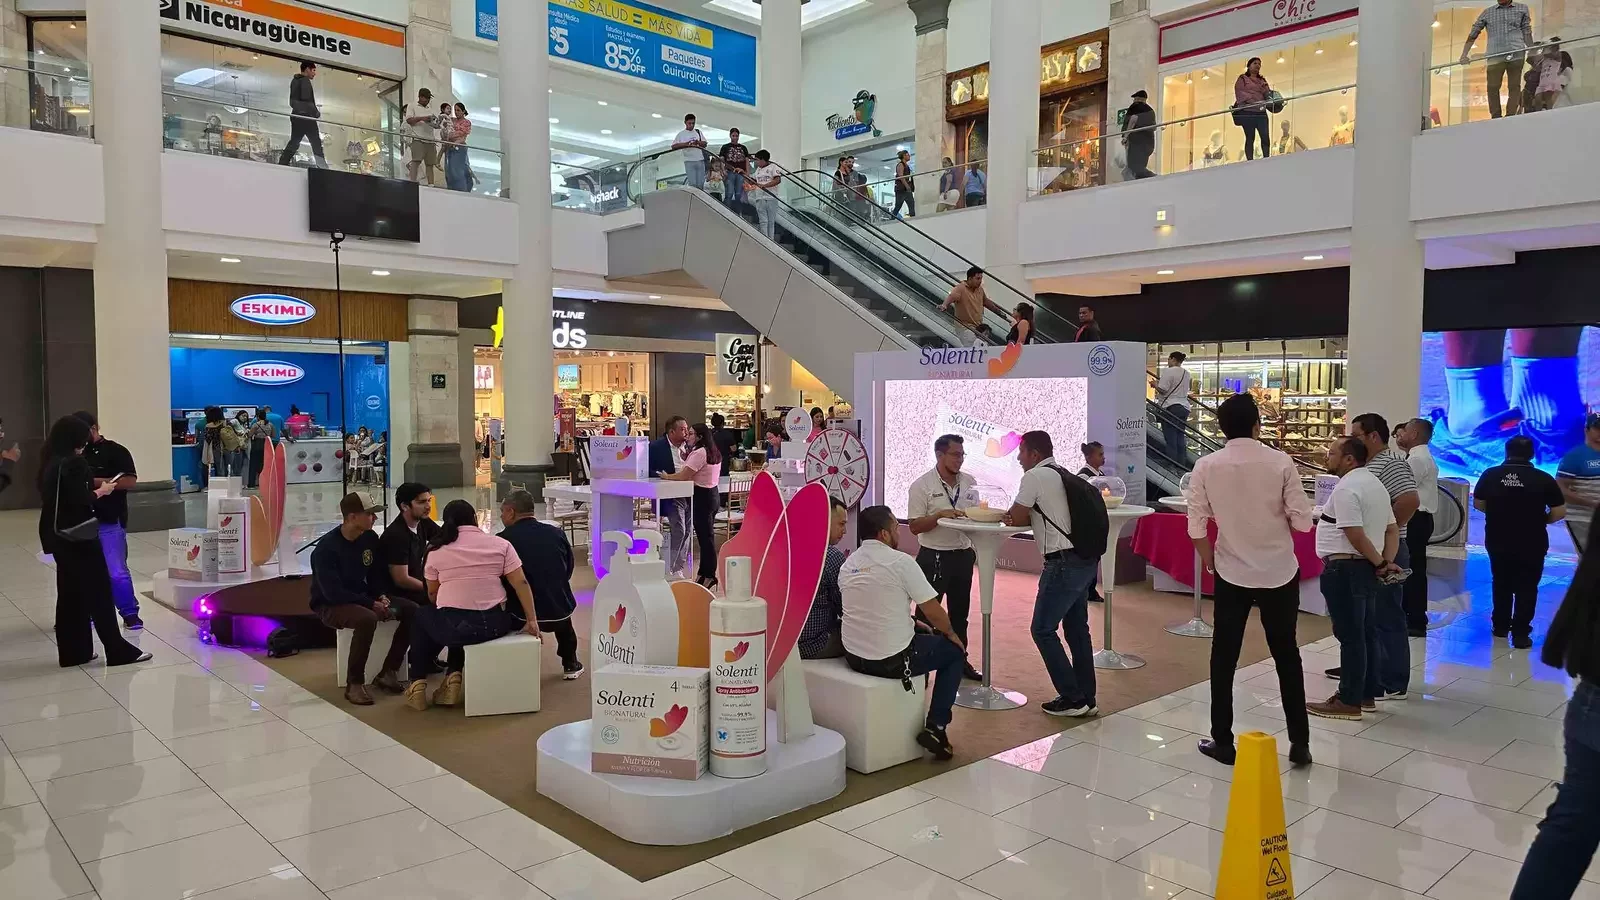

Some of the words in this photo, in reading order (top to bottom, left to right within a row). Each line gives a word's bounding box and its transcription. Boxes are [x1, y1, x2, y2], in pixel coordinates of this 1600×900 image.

[1273, 0, 1315, 20] Chic
[588, 0, 628, 21] SALUD
[648, 17, 673, 35] MÁS
[675, 25, 702, 43] VIDA
[186, 2, 351, 55] Nicaragüense
[604, 41, 642, 72] 85%
[668, 48, 706, 69] Paquetes
[630, 64, 646, 75] OFF
[662, 63, 711, 86] Quirúrgicos
[241, 303, 306, 316] ESKIMO
[552, 322, 587, 348] ds
[920, 343, 984, 366] Solenti
[1090, 356, 1112, 365] 99.9%
[244, 368, 297, 377] ESKIMO
[948, 413, 991, 435] Solenti
[1116, 417, 1144, 430] Solenti
[593, 440, 619, 448] Solenti
[170, 537, 190, 547] Solenti
[995, 557, 1017, 567] NILLA
[597, 633, 635, 665] Solenti
[715, 664, 758, 678] Solenti
[670, 681, 678, 693] 4
[596, 690, 655, 708] Solenti
[604, 708, 647, 719] BIONATURAL
[622, 755, 661, 767] Nutrición
[1261, 834, 1287, 847] CAUTION
[1262, 847, 1273, 856] Wet
[1273, 844, 1288, 853] Floor
